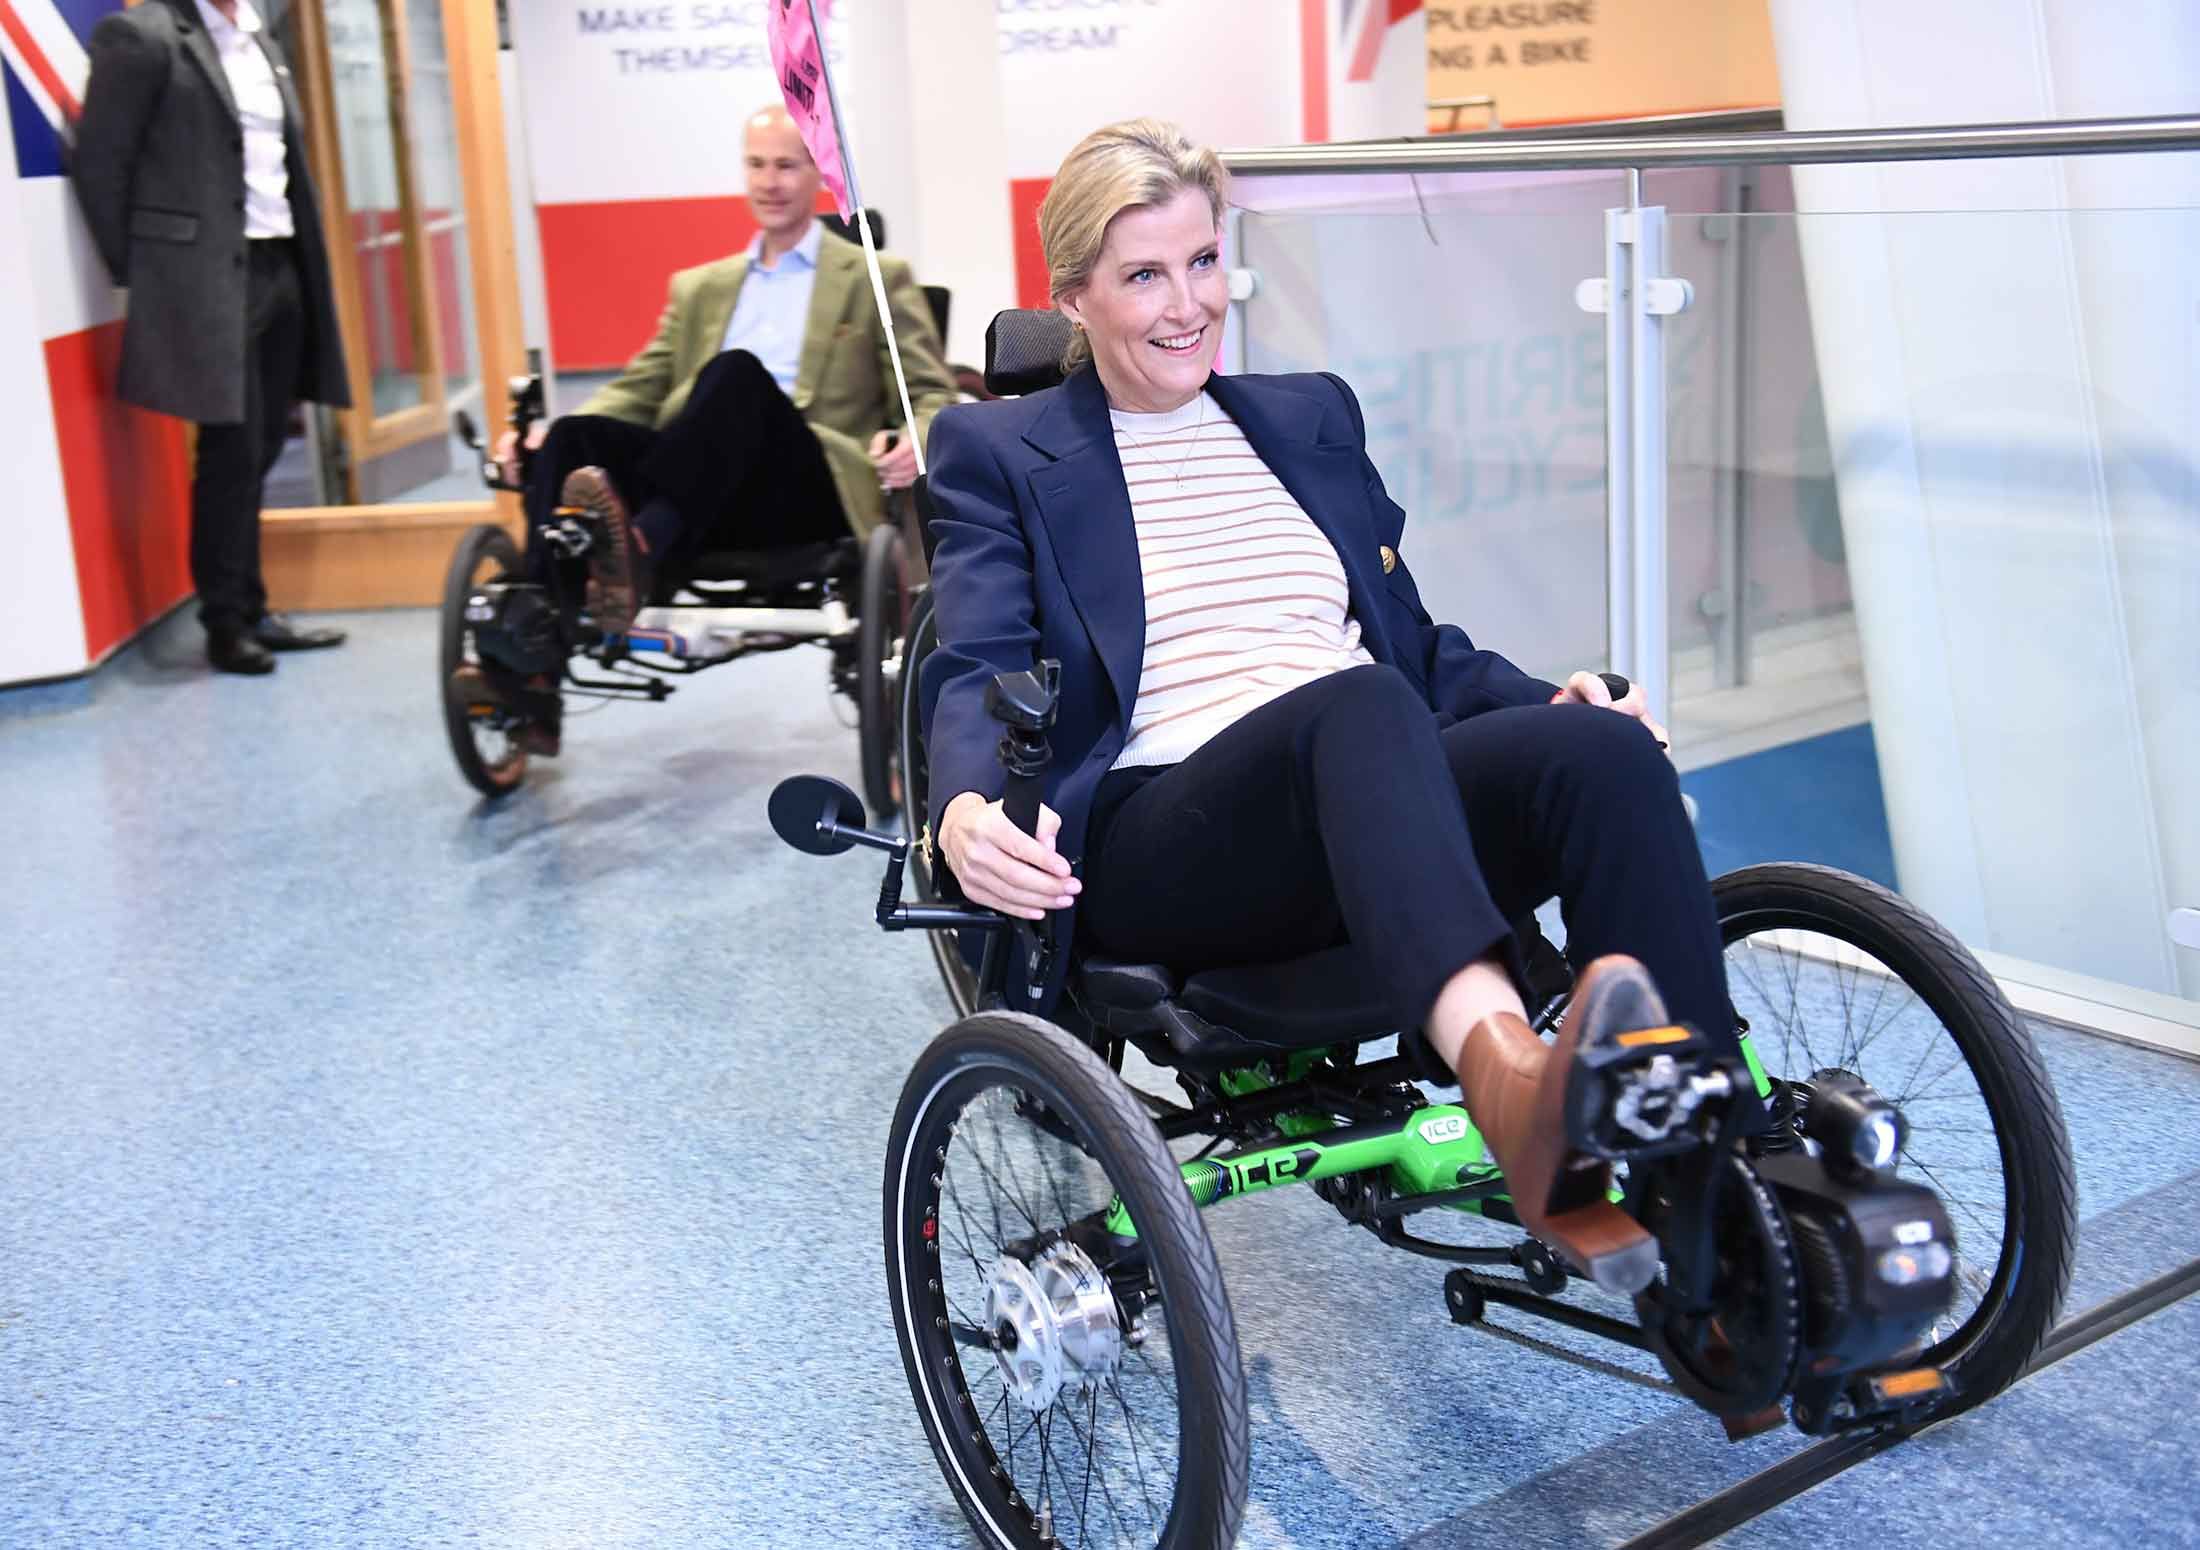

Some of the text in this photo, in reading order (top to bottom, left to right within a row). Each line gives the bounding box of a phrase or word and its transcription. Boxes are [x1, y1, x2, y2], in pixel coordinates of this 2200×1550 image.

[576, 5, 676, 34] MAKE
[1428, 38, 1592, 71] NG A BIKE
